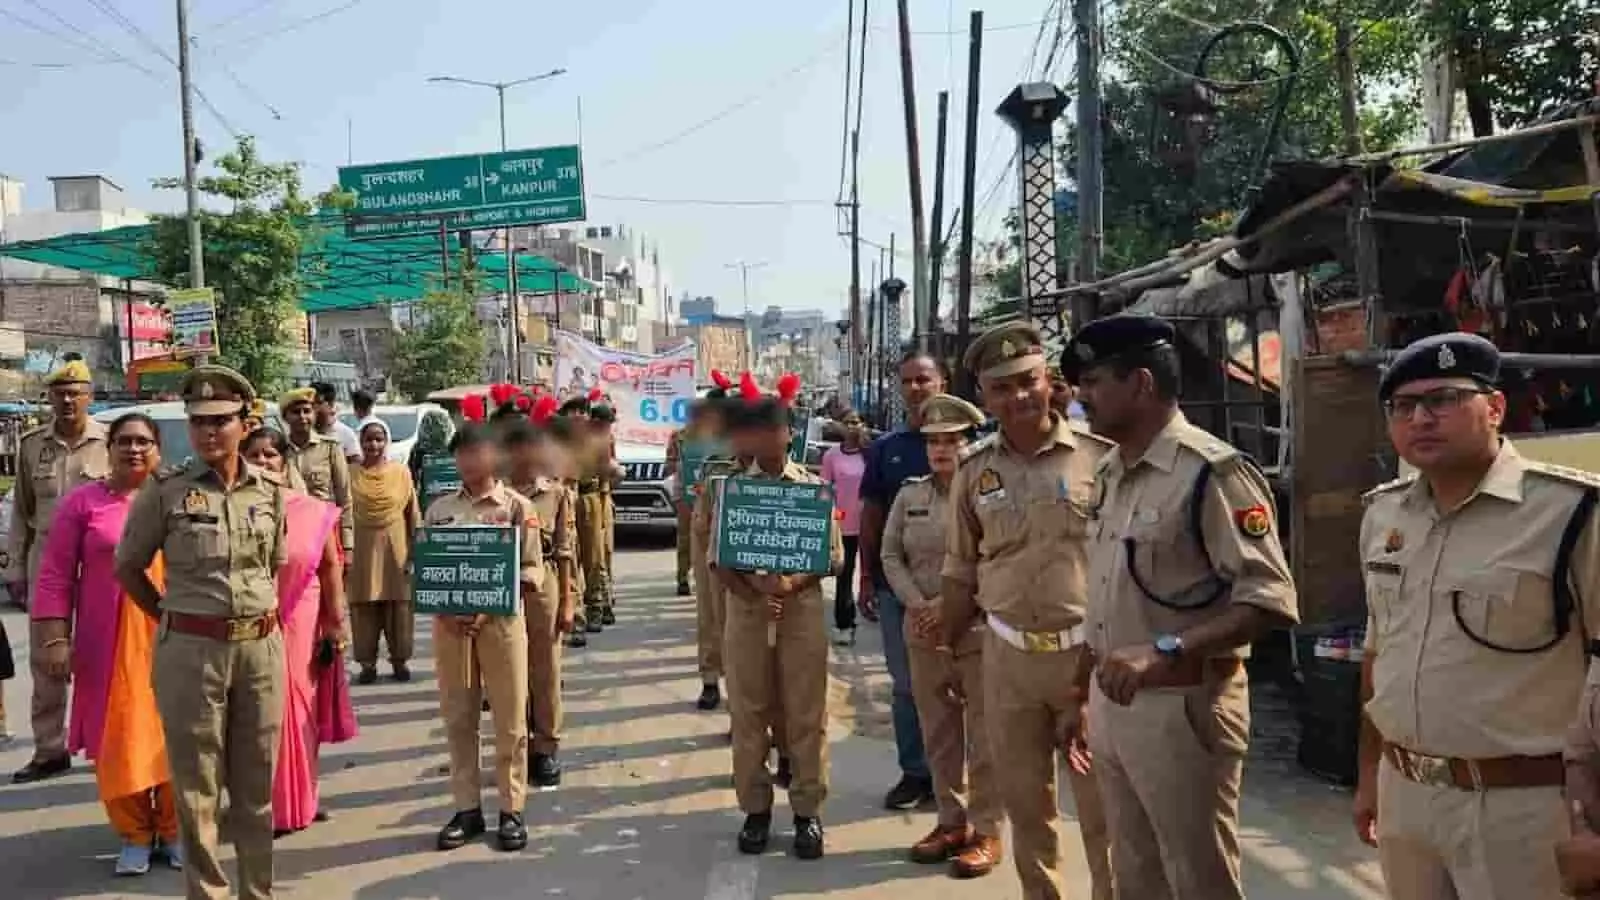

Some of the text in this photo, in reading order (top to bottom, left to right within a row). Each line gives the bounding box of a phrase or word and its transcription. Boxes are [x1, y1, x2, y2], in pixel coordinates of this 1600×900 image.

[501, 180, 558, 197] KANPUR
[362, 189, 461, 209] BULANDSHAHR
[800, 536, 822, 553] का
[736, 551, 777, 569] पालन
[421, 561, 506, 584] गलत दिशा में
